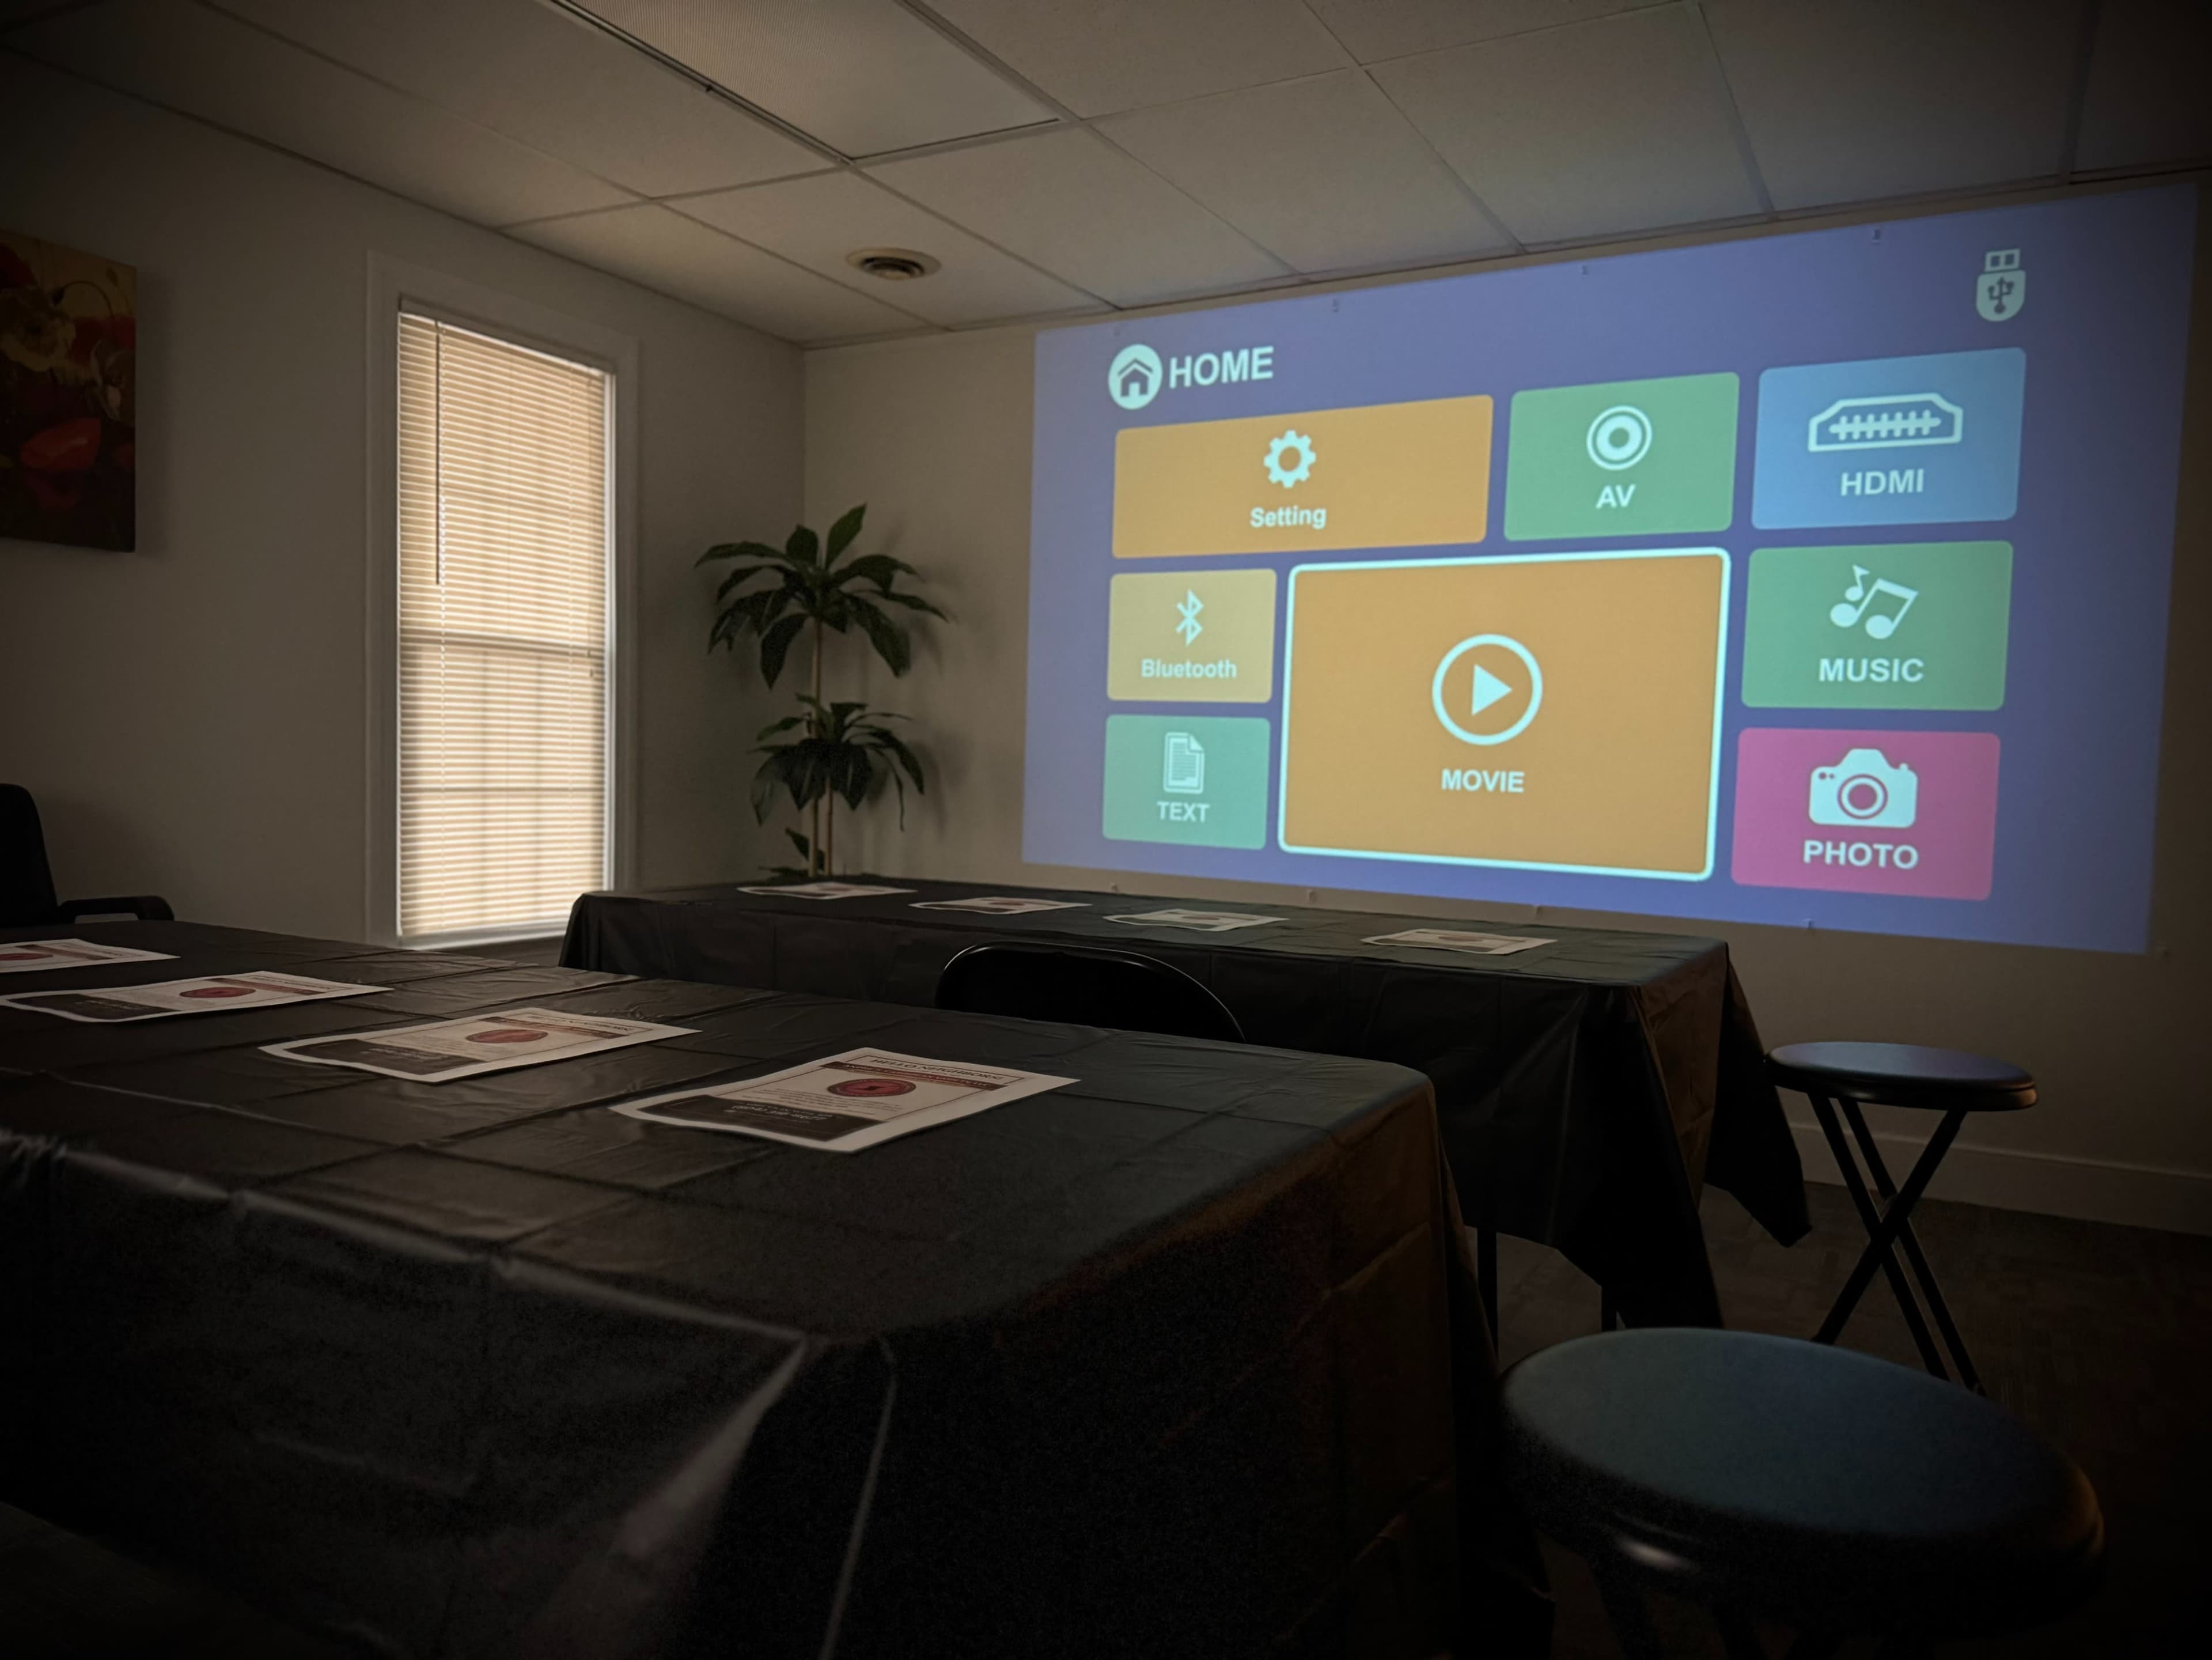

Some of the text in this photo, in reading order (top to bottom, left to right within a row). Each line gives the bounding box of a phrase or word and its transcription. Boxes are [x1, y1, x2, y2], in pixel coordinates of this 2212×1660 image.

[1169, 346, 1274, 389] HOME
[1840, 468, 1925, 496] HDMI
[1595, 484, 1637, 509] AV
[1250, 505, 1327, 530] Setting
[1141, 658, 1237, 679] Bluetooth
[1819, 658, 1925, 682] MUSIC
[1441, 769, 1525, 793] MOVIE
[1156, 801, 1211, 823] TEXT
[1803, 840, 1919, 869] PHOTO
[870, 1059, 916, 1068] HELLO
